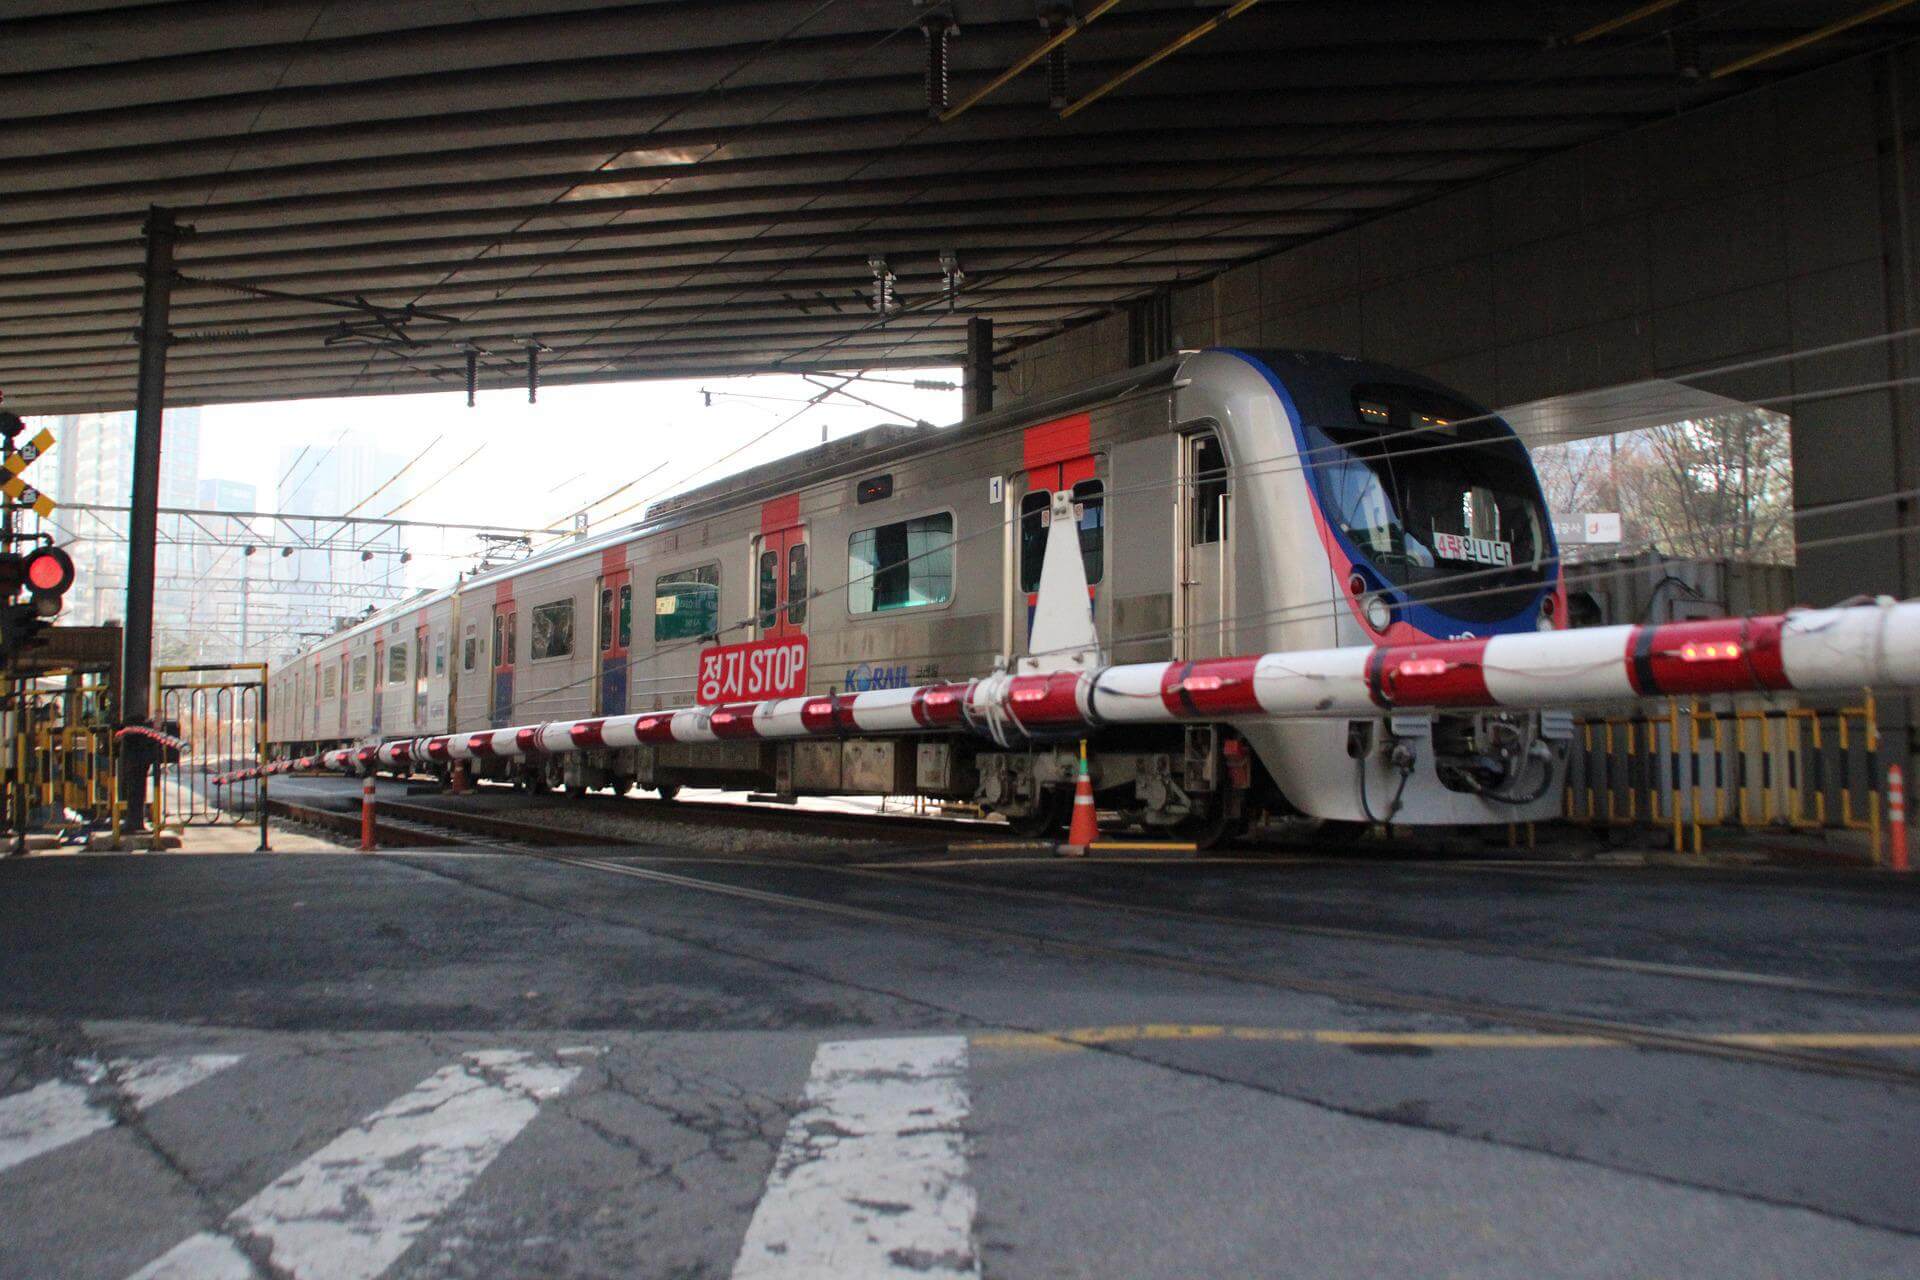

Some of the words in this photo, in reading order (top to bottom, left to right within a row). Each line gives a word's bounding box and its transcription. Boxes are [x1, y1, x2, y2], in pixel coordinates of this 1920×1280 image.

[992, 480, 999, 499] 1
[702, 650, 745, 700] 정지
[748, 644, 804, 693] STOP
